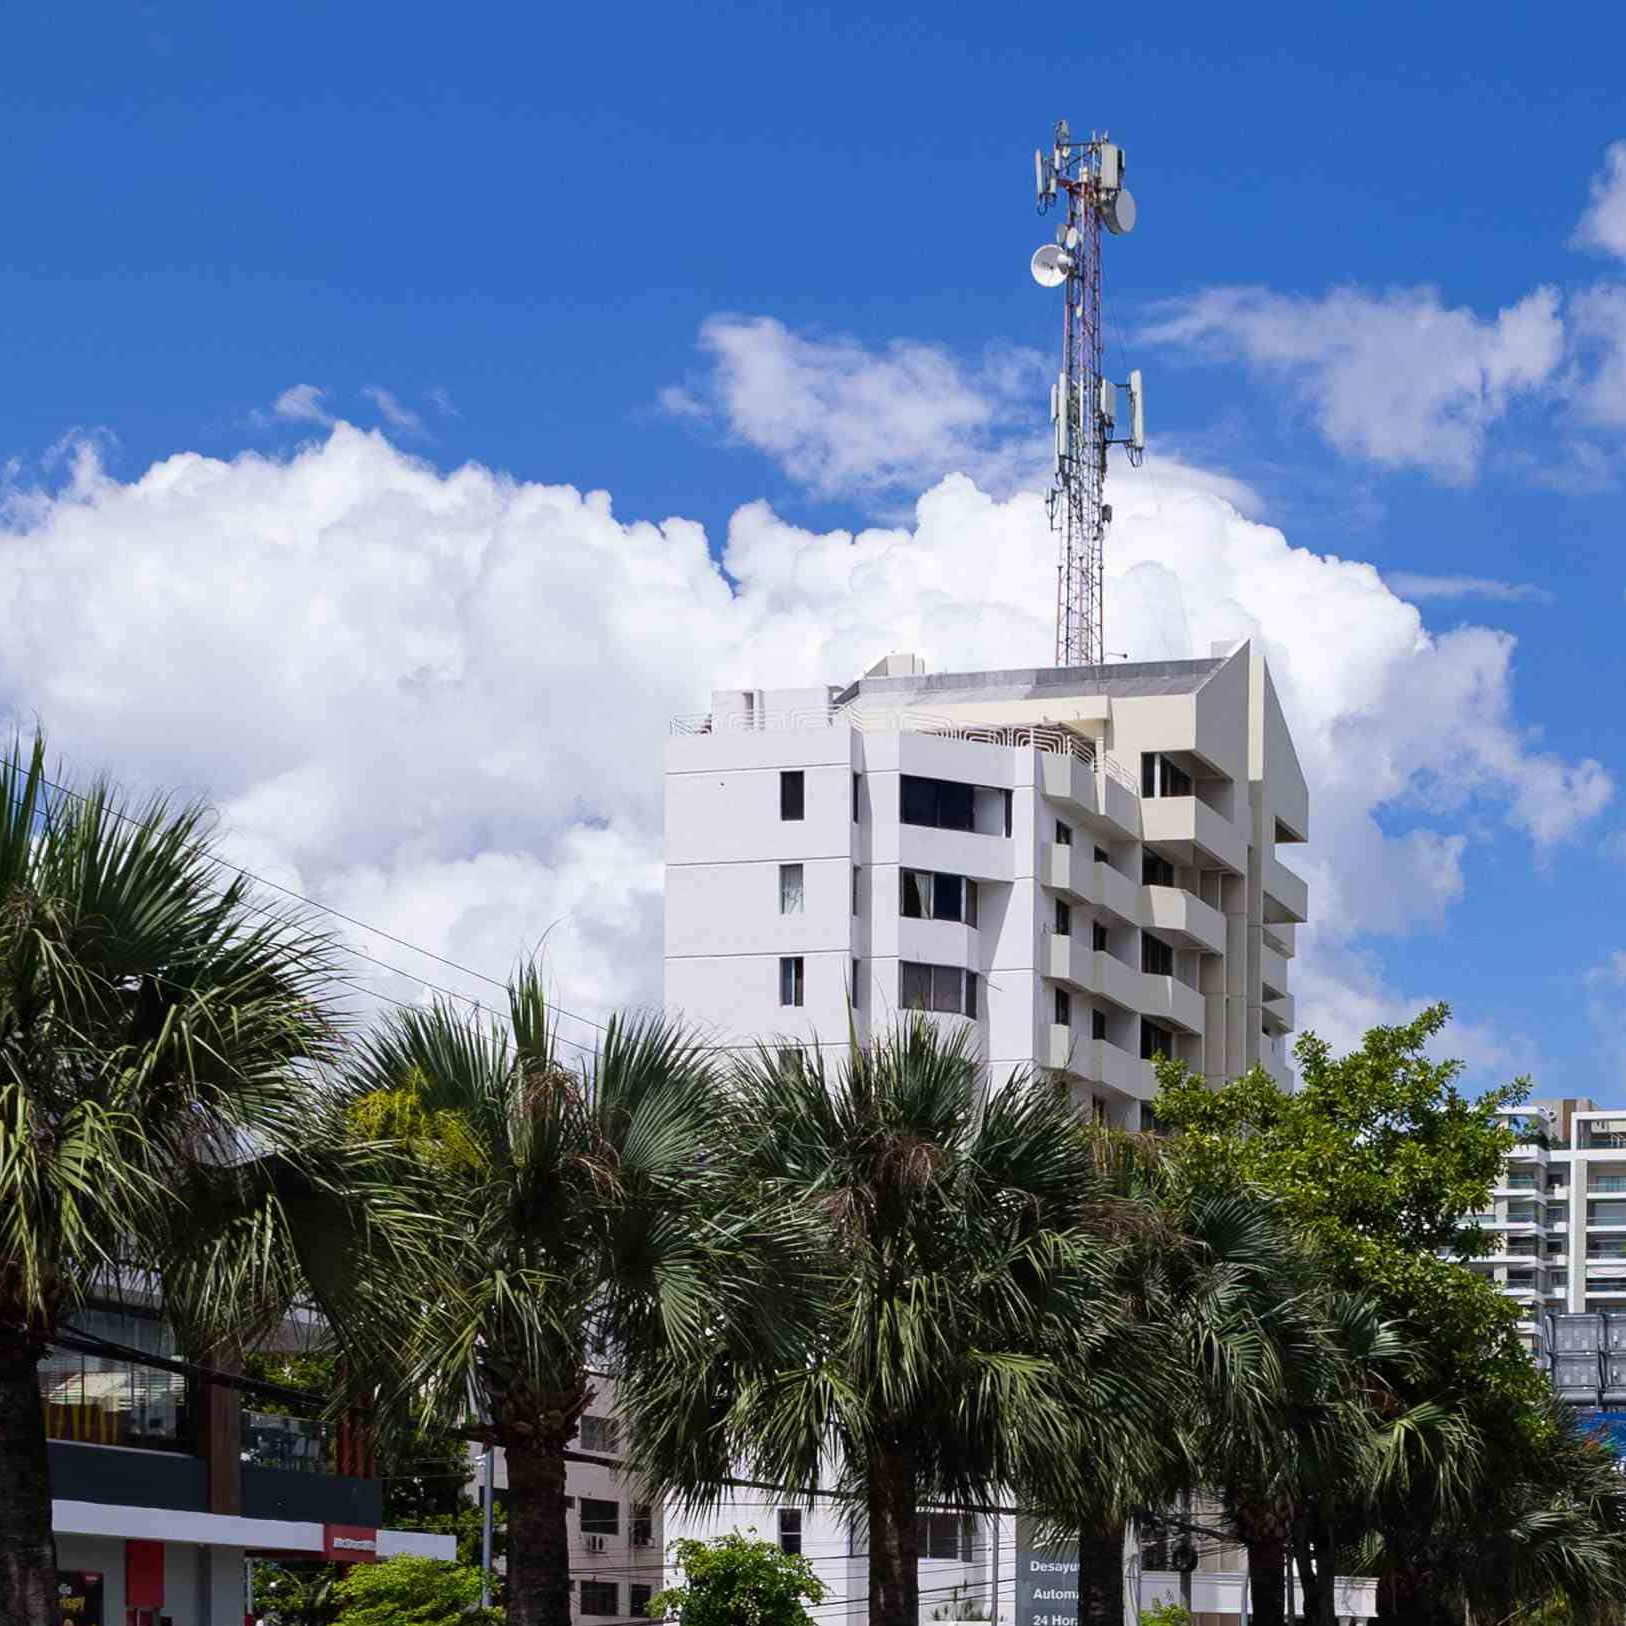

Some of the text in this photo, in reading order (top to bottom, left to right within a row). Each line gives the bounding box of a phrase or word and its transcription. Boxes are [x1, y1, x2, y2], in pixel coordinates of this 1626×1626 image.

[1030, 1560, 1080, 1575] Desayu
[1033, 1614, 1078, 1626] 24 Hor
